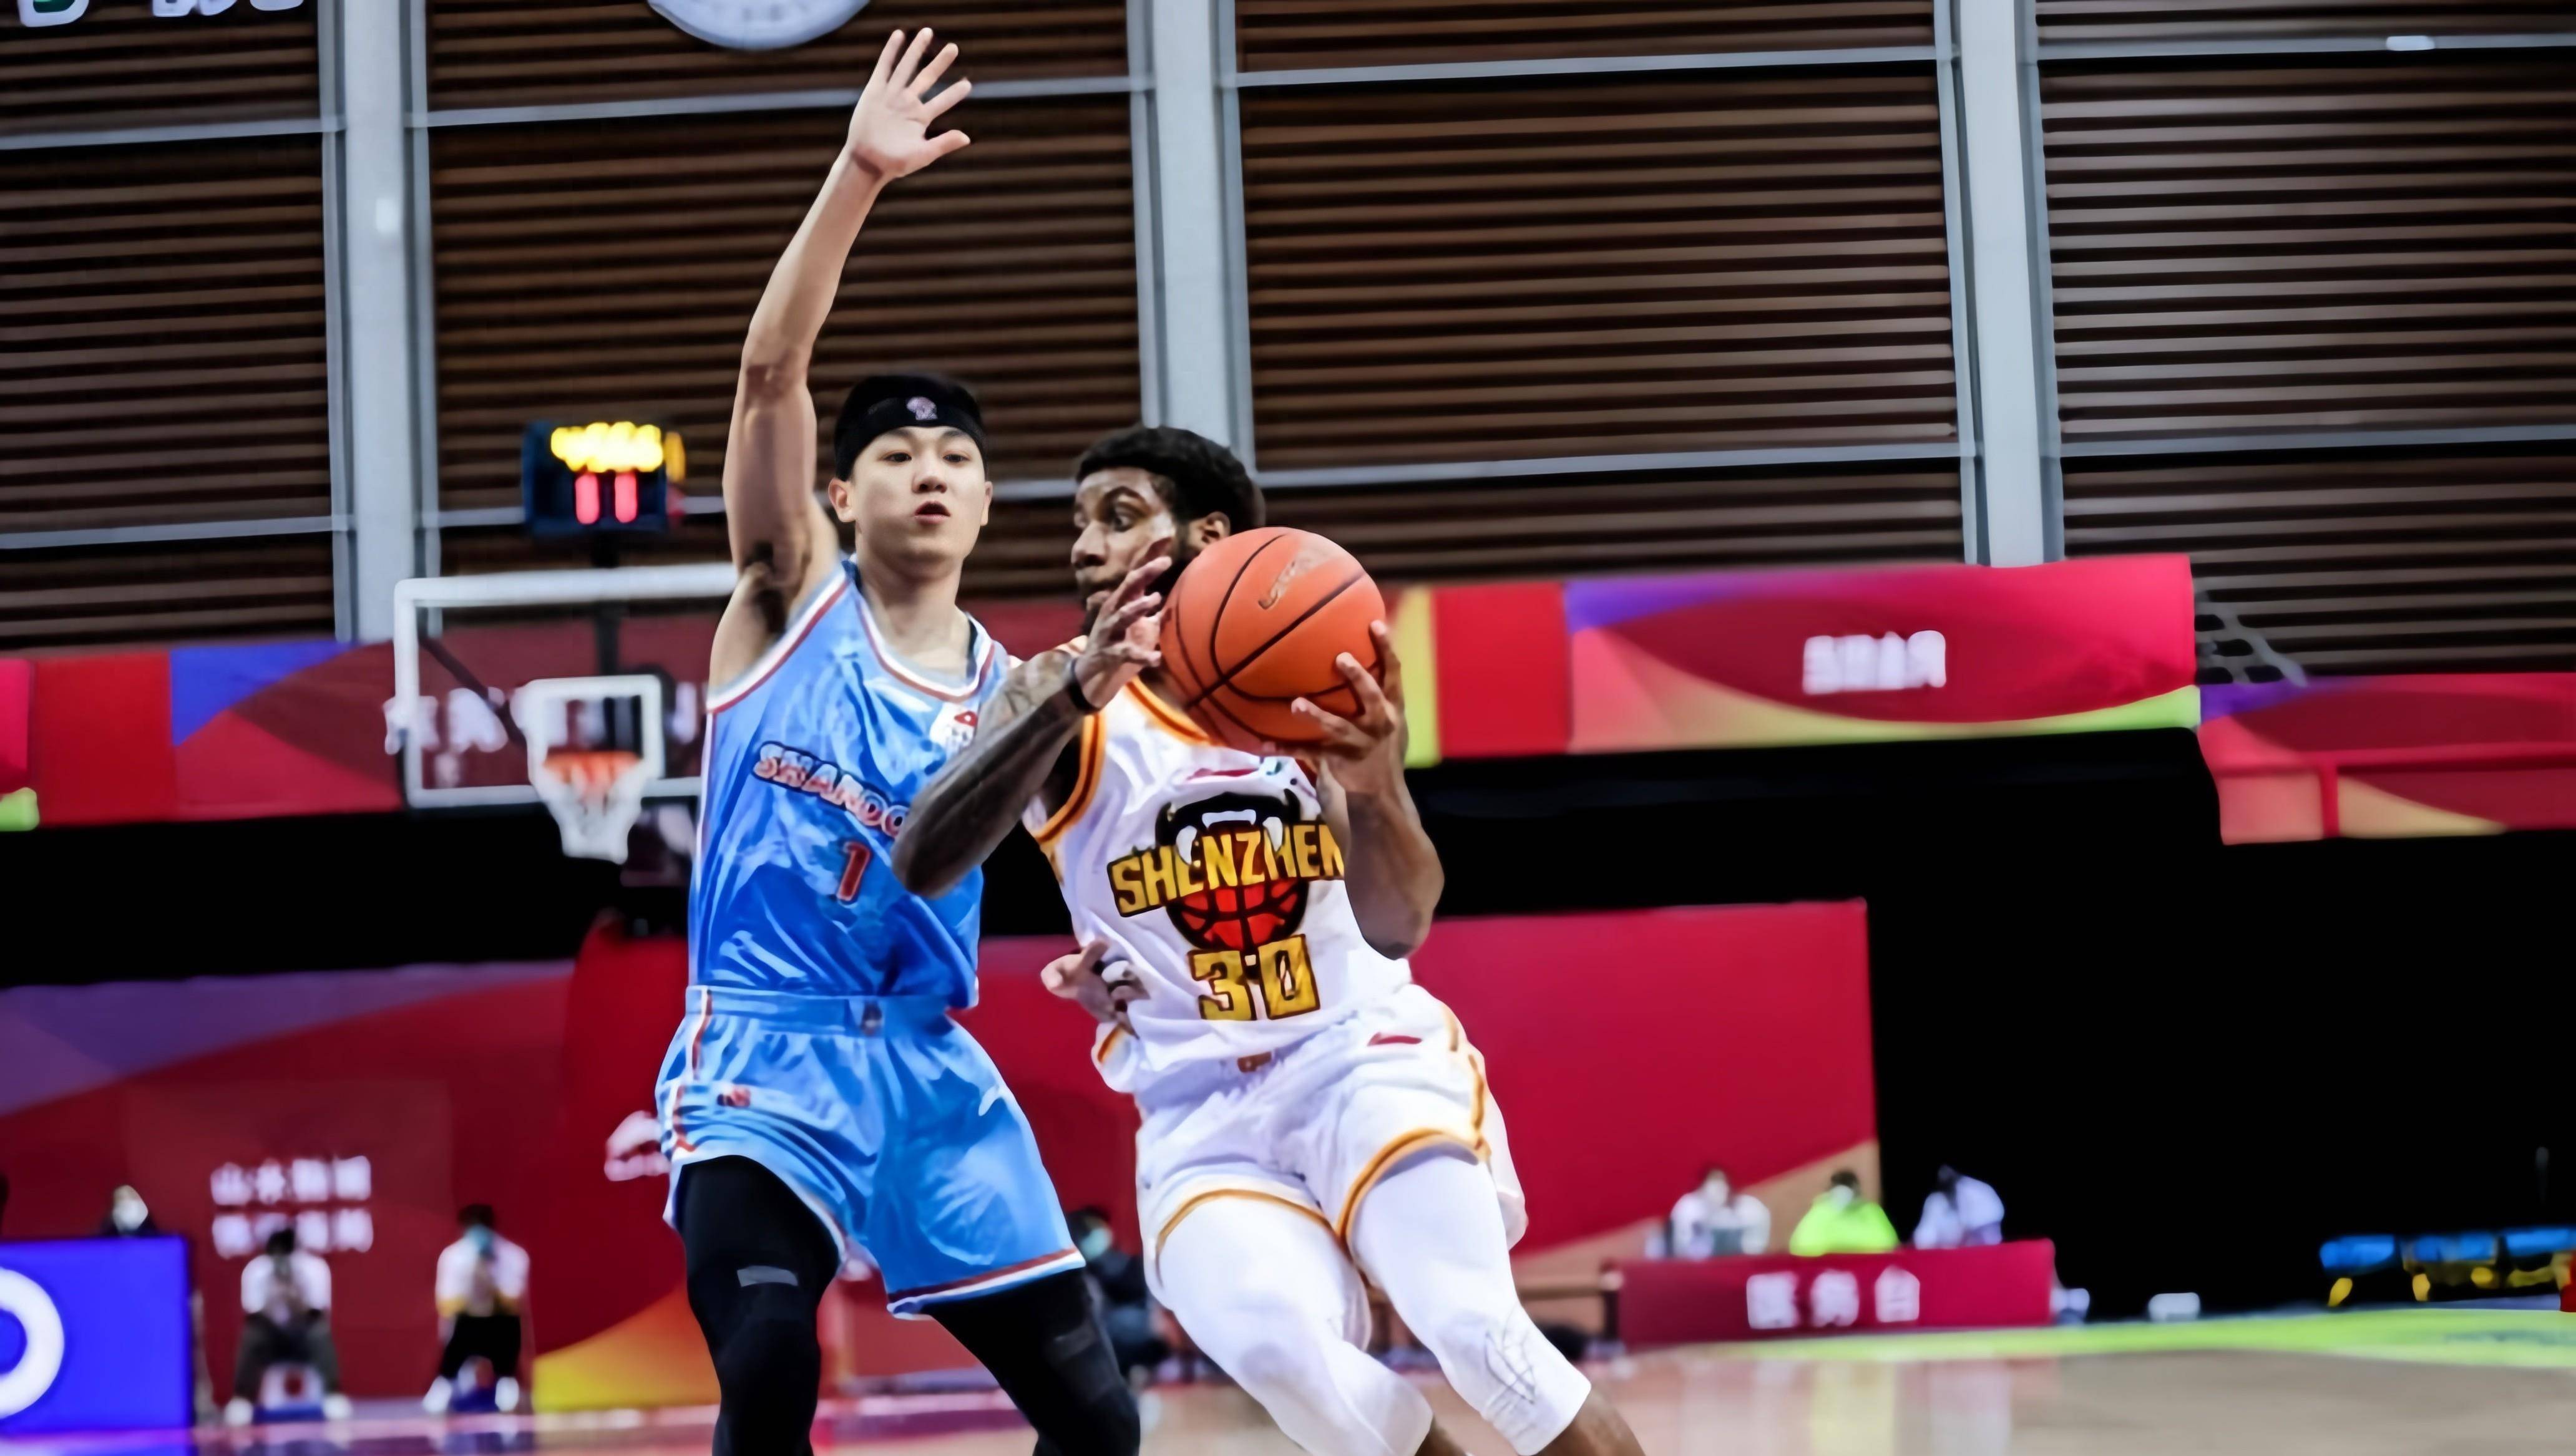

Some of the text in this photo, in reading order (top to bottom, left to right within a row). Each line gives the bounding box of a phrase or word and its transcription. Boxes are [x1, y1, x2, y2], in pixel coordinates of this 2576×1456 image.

[836, 840, 871, 905] 1
[1108, 821, 1345, 917] SHENZHEN
[1188, 934, 1320, 1021] 30
